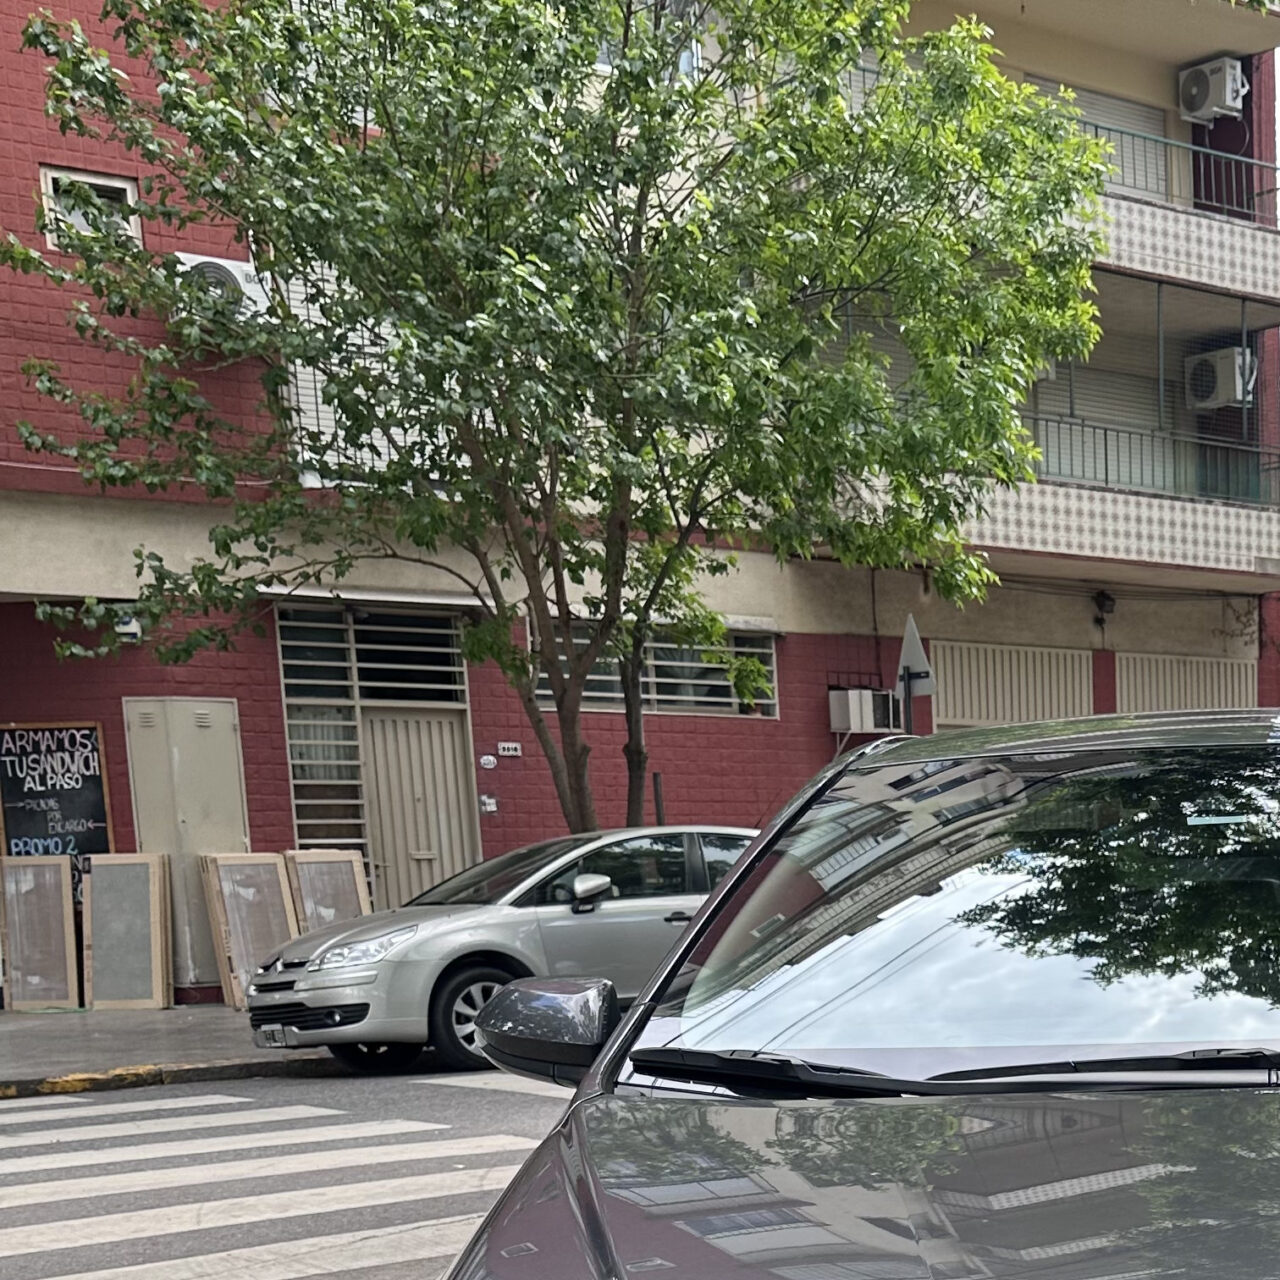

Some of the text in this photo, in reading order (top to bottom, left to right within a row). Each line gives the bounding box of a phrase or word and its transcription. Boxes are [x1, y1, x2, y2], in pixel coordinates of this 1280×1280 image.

[1, 729, 92, 754] ARMAMOS
[0, 756, 27, 778] TU
[23, 773, 82, 792] AL PASO
[11, 835, 78, 856] PROMO 2
